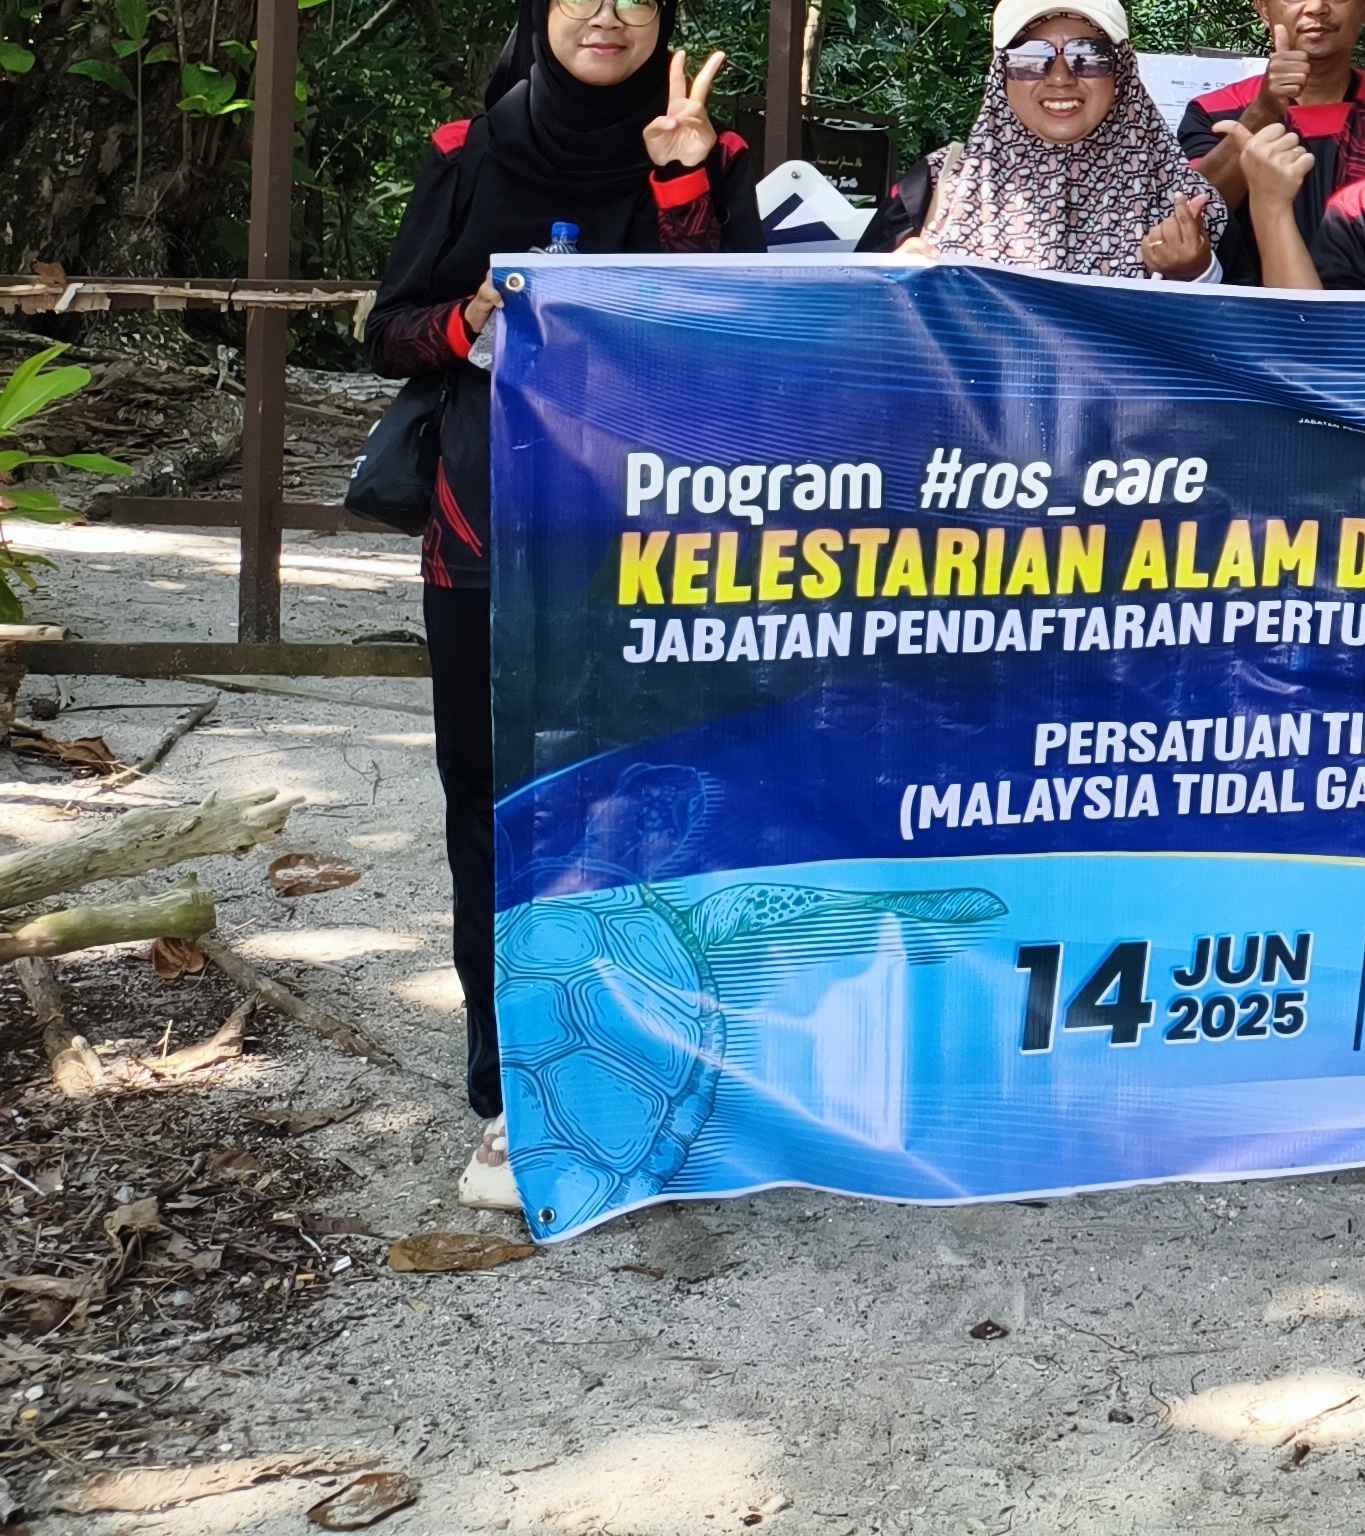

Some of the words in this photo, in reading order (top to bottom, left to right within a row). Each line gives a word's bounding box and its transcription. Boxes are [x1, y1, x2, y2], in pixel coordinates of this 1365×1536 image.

[626, 453, 882, 525] Program
[920, 448, 1208, 516] #ros_care
[618, 523, 1107, 606] KELESTARIAN
[1122, 518, 1320, 593] ALAM
[622, 611, 853, 664] JABATAN
[862, 601, 1212, 657] PENDAFTARAN
[1034, 713, 1312, 767] PERSATUAN
[899, 773, 1160, 842] (MALAYSIA
[1172, 768, 1305, 817] TIDAL
[1171, 930, 1315, 991] JUN
[1014, 940, 1157, 1055] 14
[1163, 990, 1308, 1045] 2025
